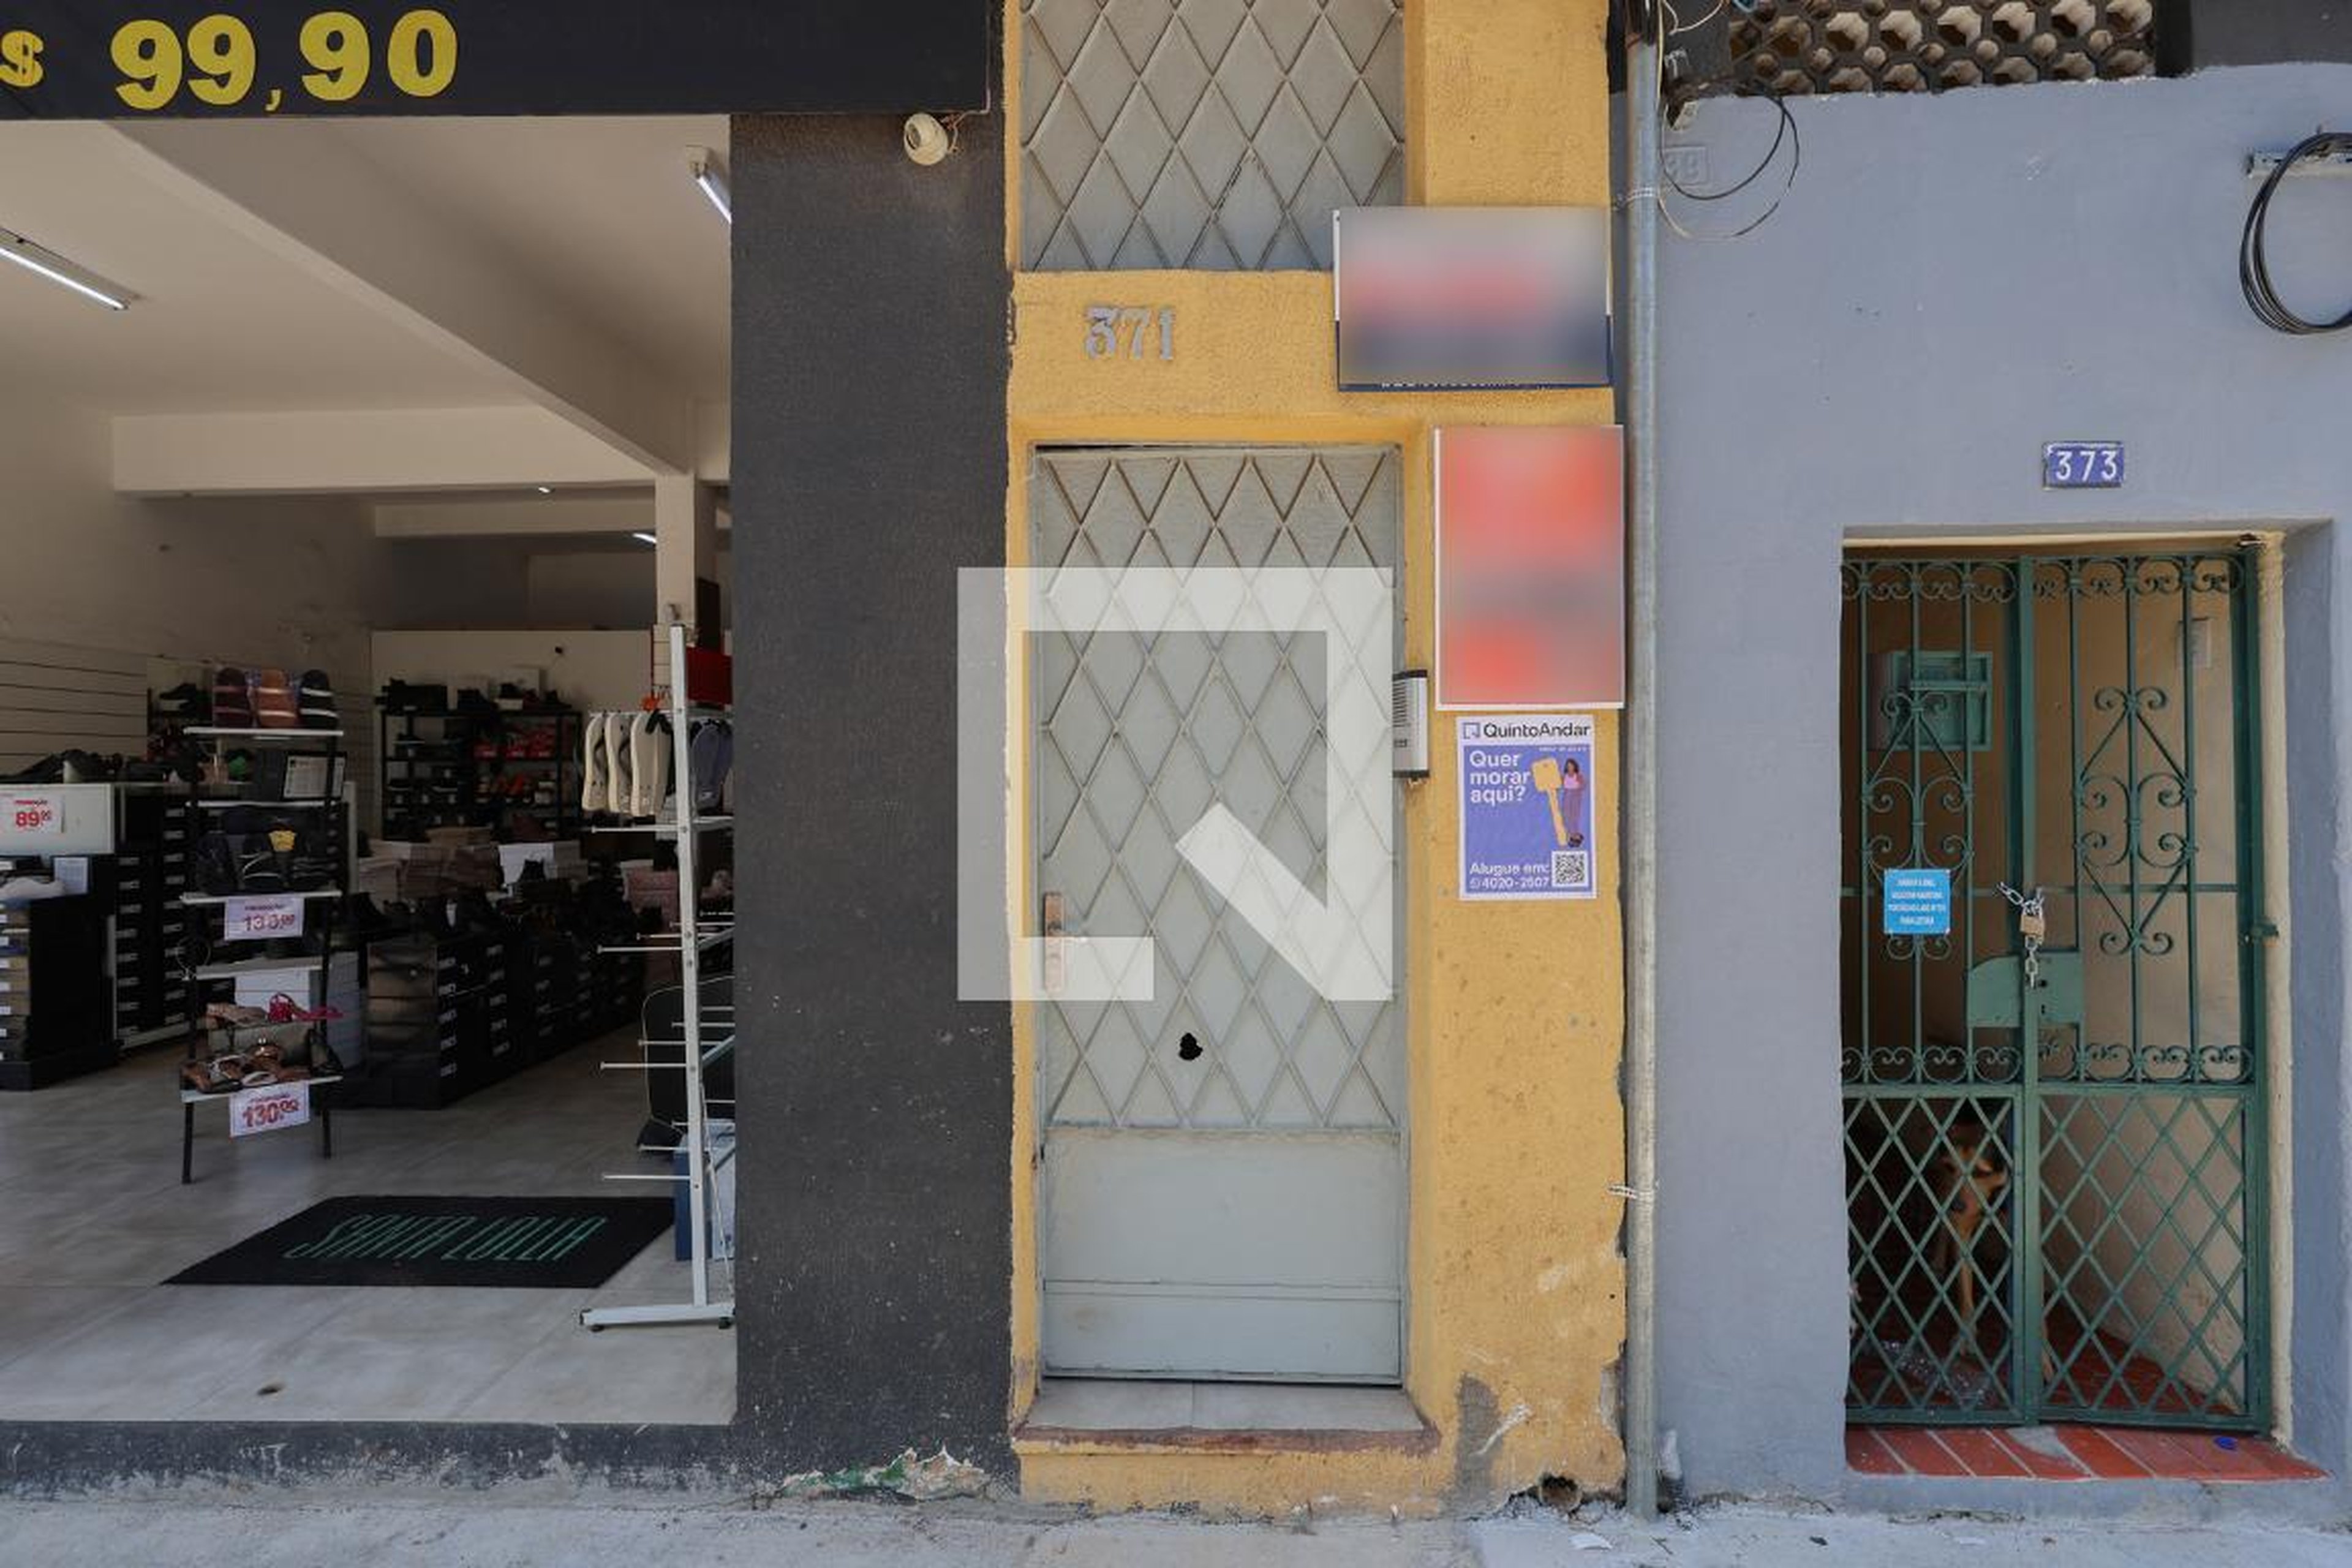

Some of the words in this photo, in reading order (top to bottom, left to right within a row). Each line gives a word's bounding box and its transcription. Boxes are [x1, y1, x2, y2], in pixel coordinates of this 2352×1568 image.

[110, 9, 458, 111] 99,90
[1084, 305, 1176, 360] 371
[2055, 451, 2117, 481] 373
[1483, 722, 1591, 738] QuintoAndar
[1469, 750, 1522, 767] Quer
[1469, 770, 1531, 785] morar
[1469, 785, 1527, 806] aqui?
[1469, 862, 1520, 877] Alugue
[282, 1214, 479, 1260] SANTA
[440, 1215, 609, 1261] LOLLA
